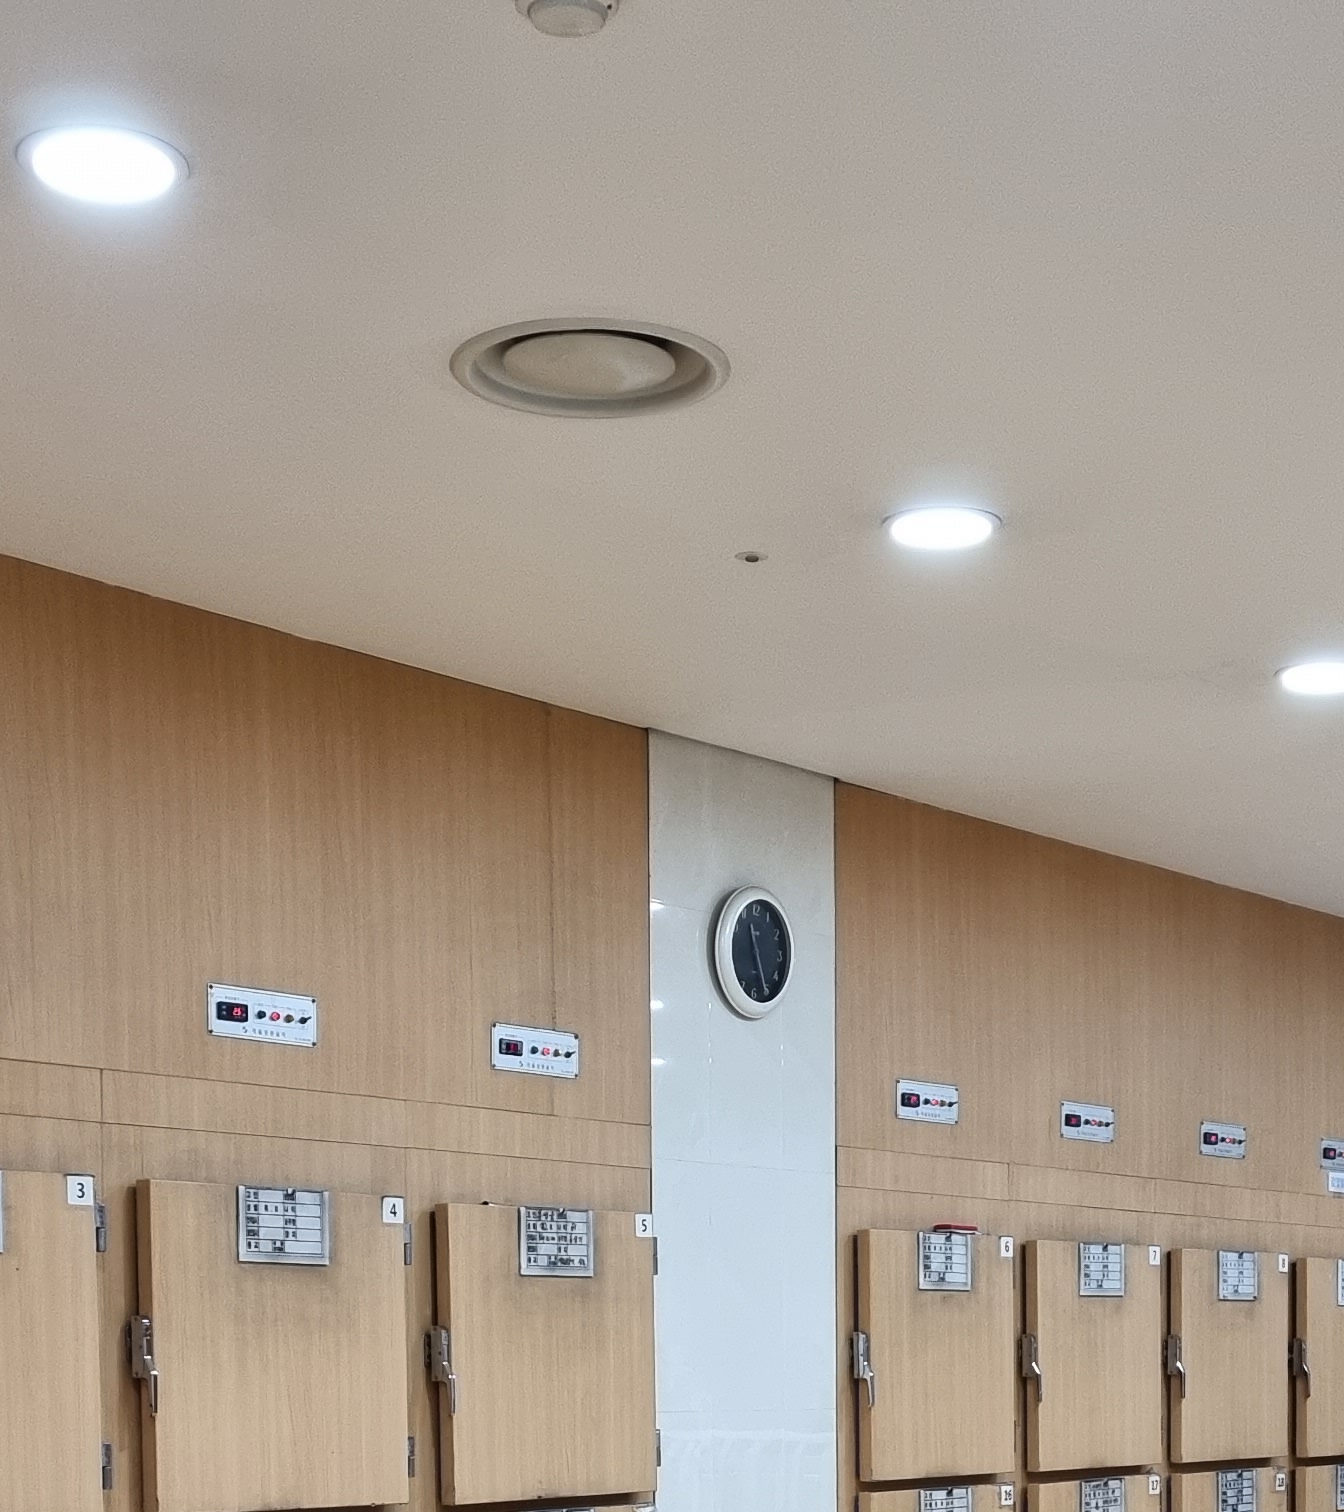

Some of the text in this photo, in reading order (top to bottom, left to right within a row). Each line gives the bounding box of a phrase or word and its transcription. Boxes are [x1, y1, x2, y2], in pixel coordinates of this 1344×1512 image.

[752, 904, 760, 917] 12
[766, 912, 769, 923] 1
[774, 929, 779, 941] 2
[777, 950, 782, 962] 3
[773, 971, 778, 981] 4
[751, 988, 757, 999] 6
[76, 1183, 85, 1199] 3
[390, 1203, 397, 1217] 4
[641, 1219, 648, 1232] 5
[1004, 1241, 1010, 1252] 6
[1152, 1250, 1157, 1261] 7
[1151, 1480, 1159, 1491] 17
